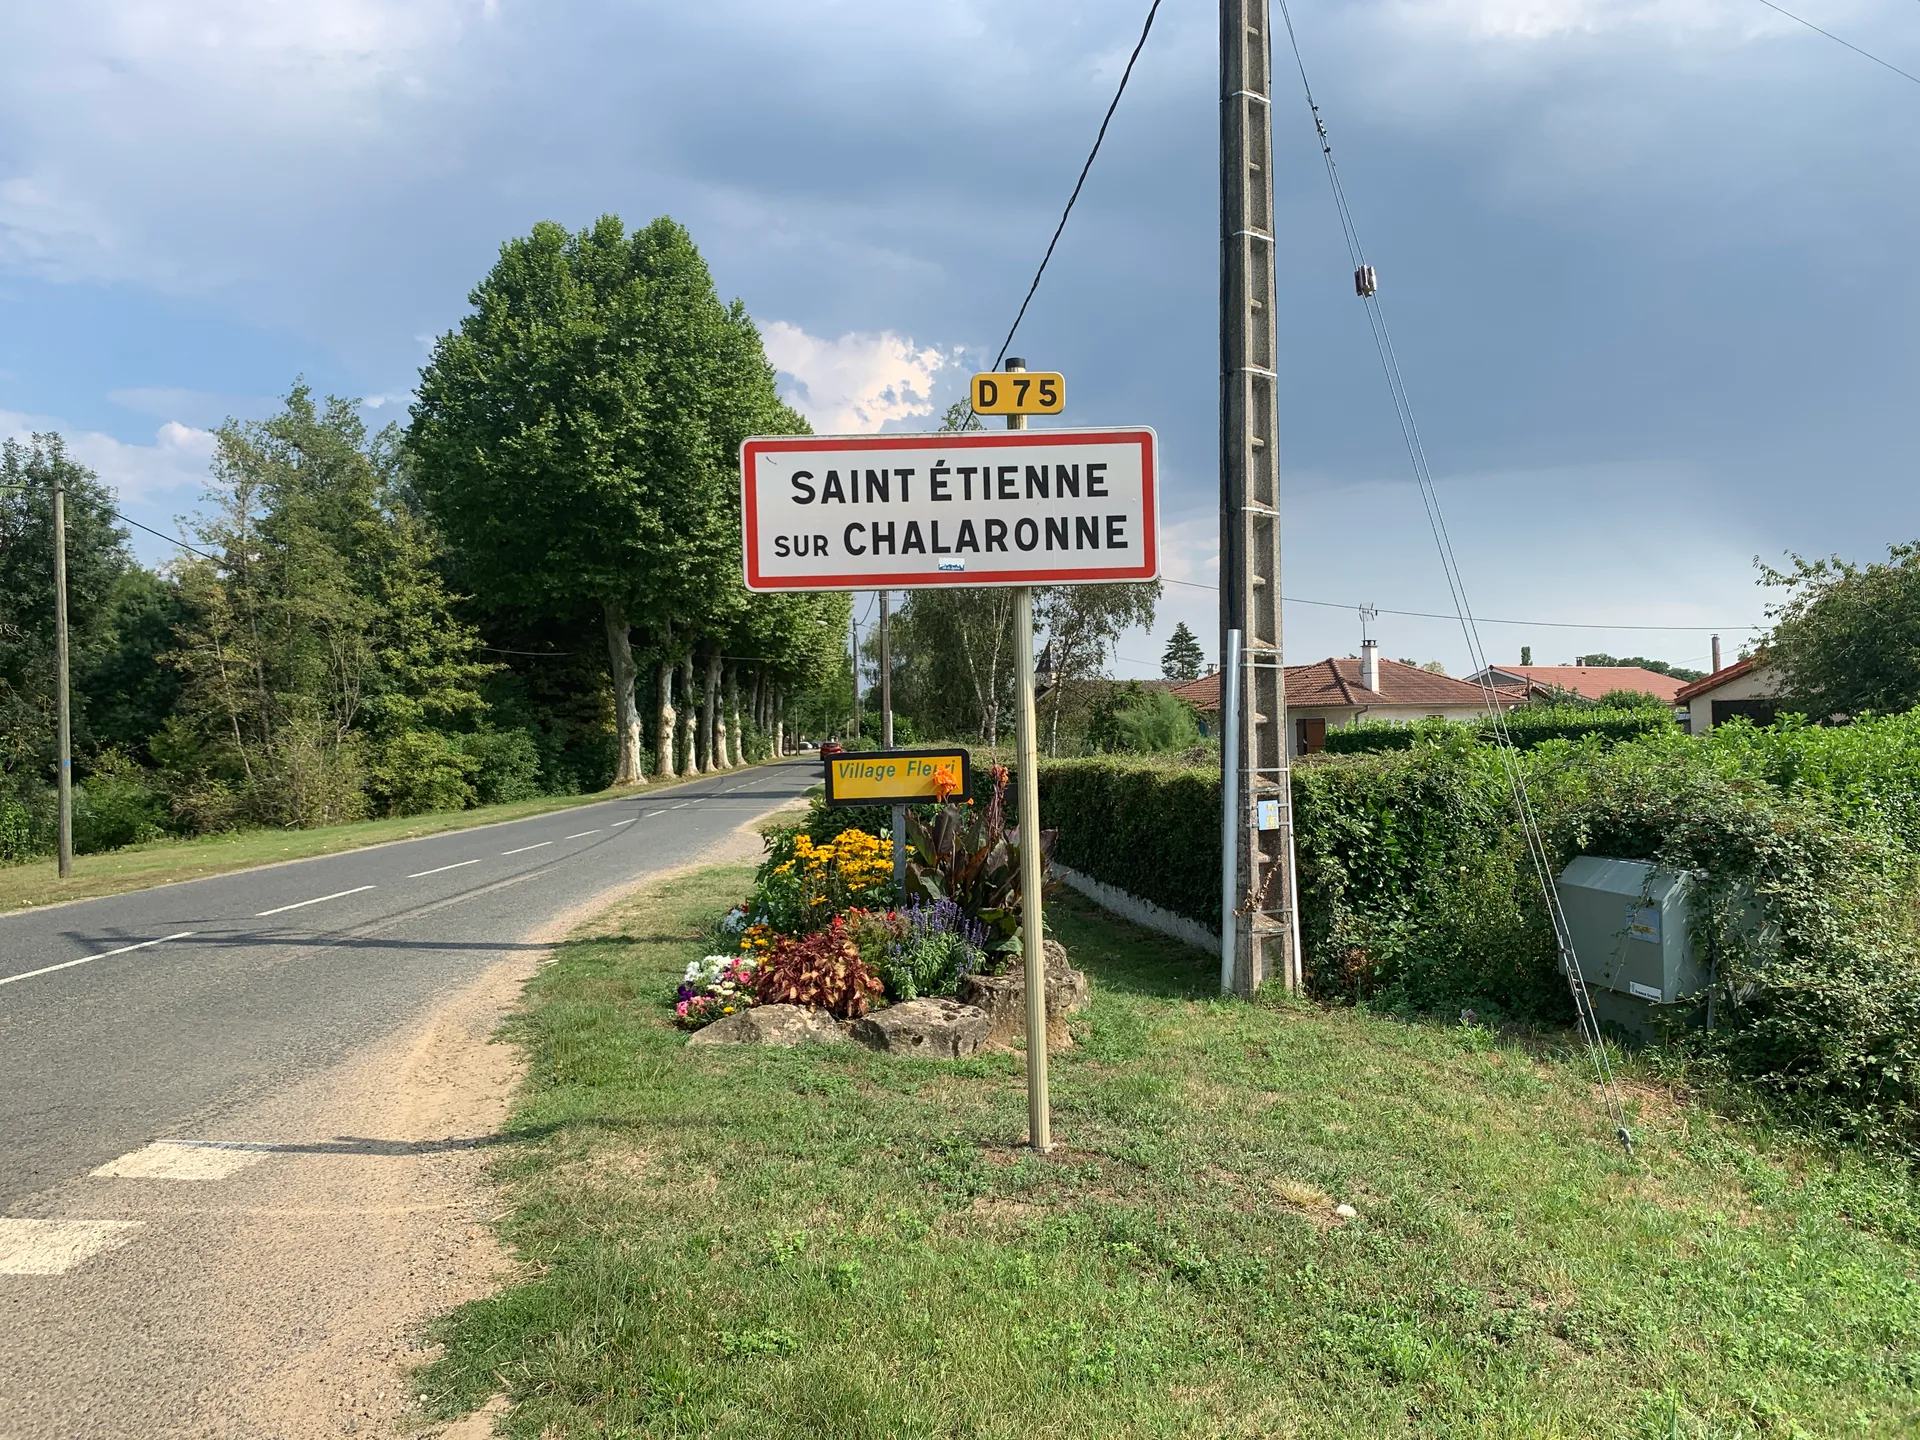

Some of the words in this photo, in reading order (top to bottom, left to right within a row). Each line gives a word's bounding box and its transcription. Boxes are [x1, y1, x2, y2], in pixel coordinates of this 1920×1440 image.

[979, 380, 998, 407] D
[1012, 379, 1058, 407] 75
[791, 468, 915, 504] SAINT
[929, 459, 1109, 501] ÉTIENNE
[774, 534, 829, 557] SUR
[843, 514, 1129, 556] CHALARONNE
[839, 762, 895, 781] Village
[907, 760, 955, 776] Flei
